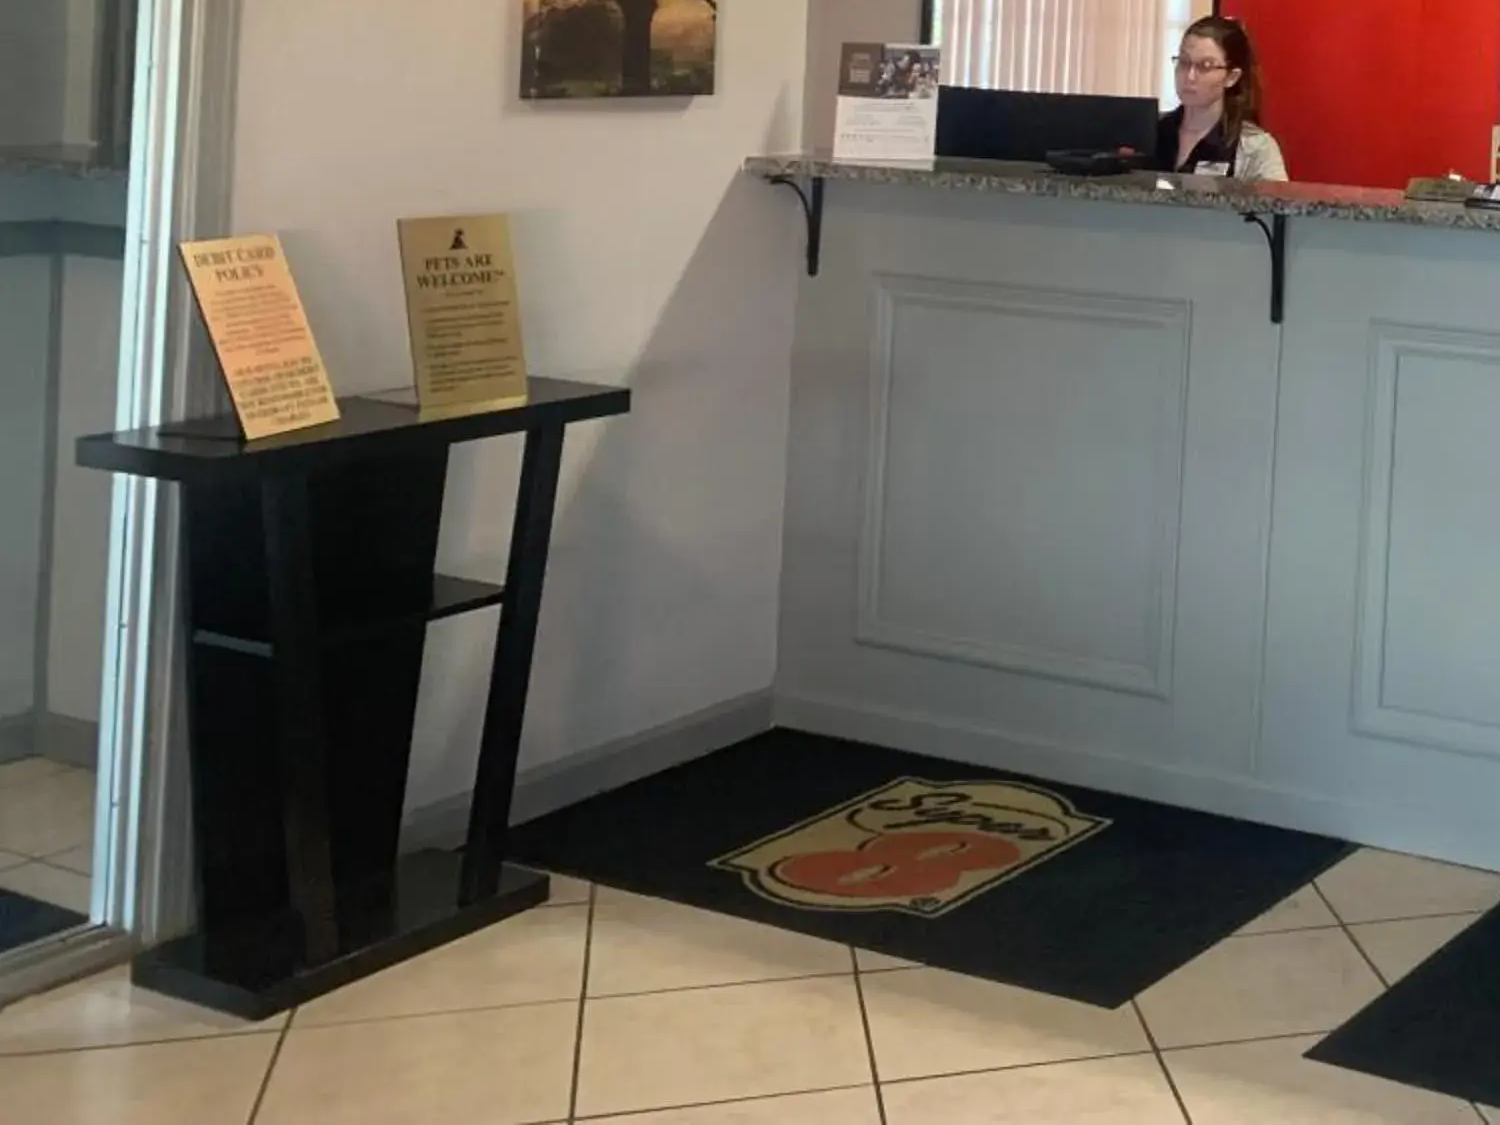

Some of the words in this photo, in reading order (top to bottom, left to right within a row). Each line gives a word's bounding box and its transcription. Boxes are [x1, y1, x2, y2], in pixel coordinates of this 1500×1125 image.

[236, 246, 275, 262] CARD
[423, 255, 460, 272] PETS
[463, 253, 493, 268] ARE
[215, 263, 265, 282] POLICY
[868, 792, 1059, 842] Super
[766, 831, 1023, 898] 8
